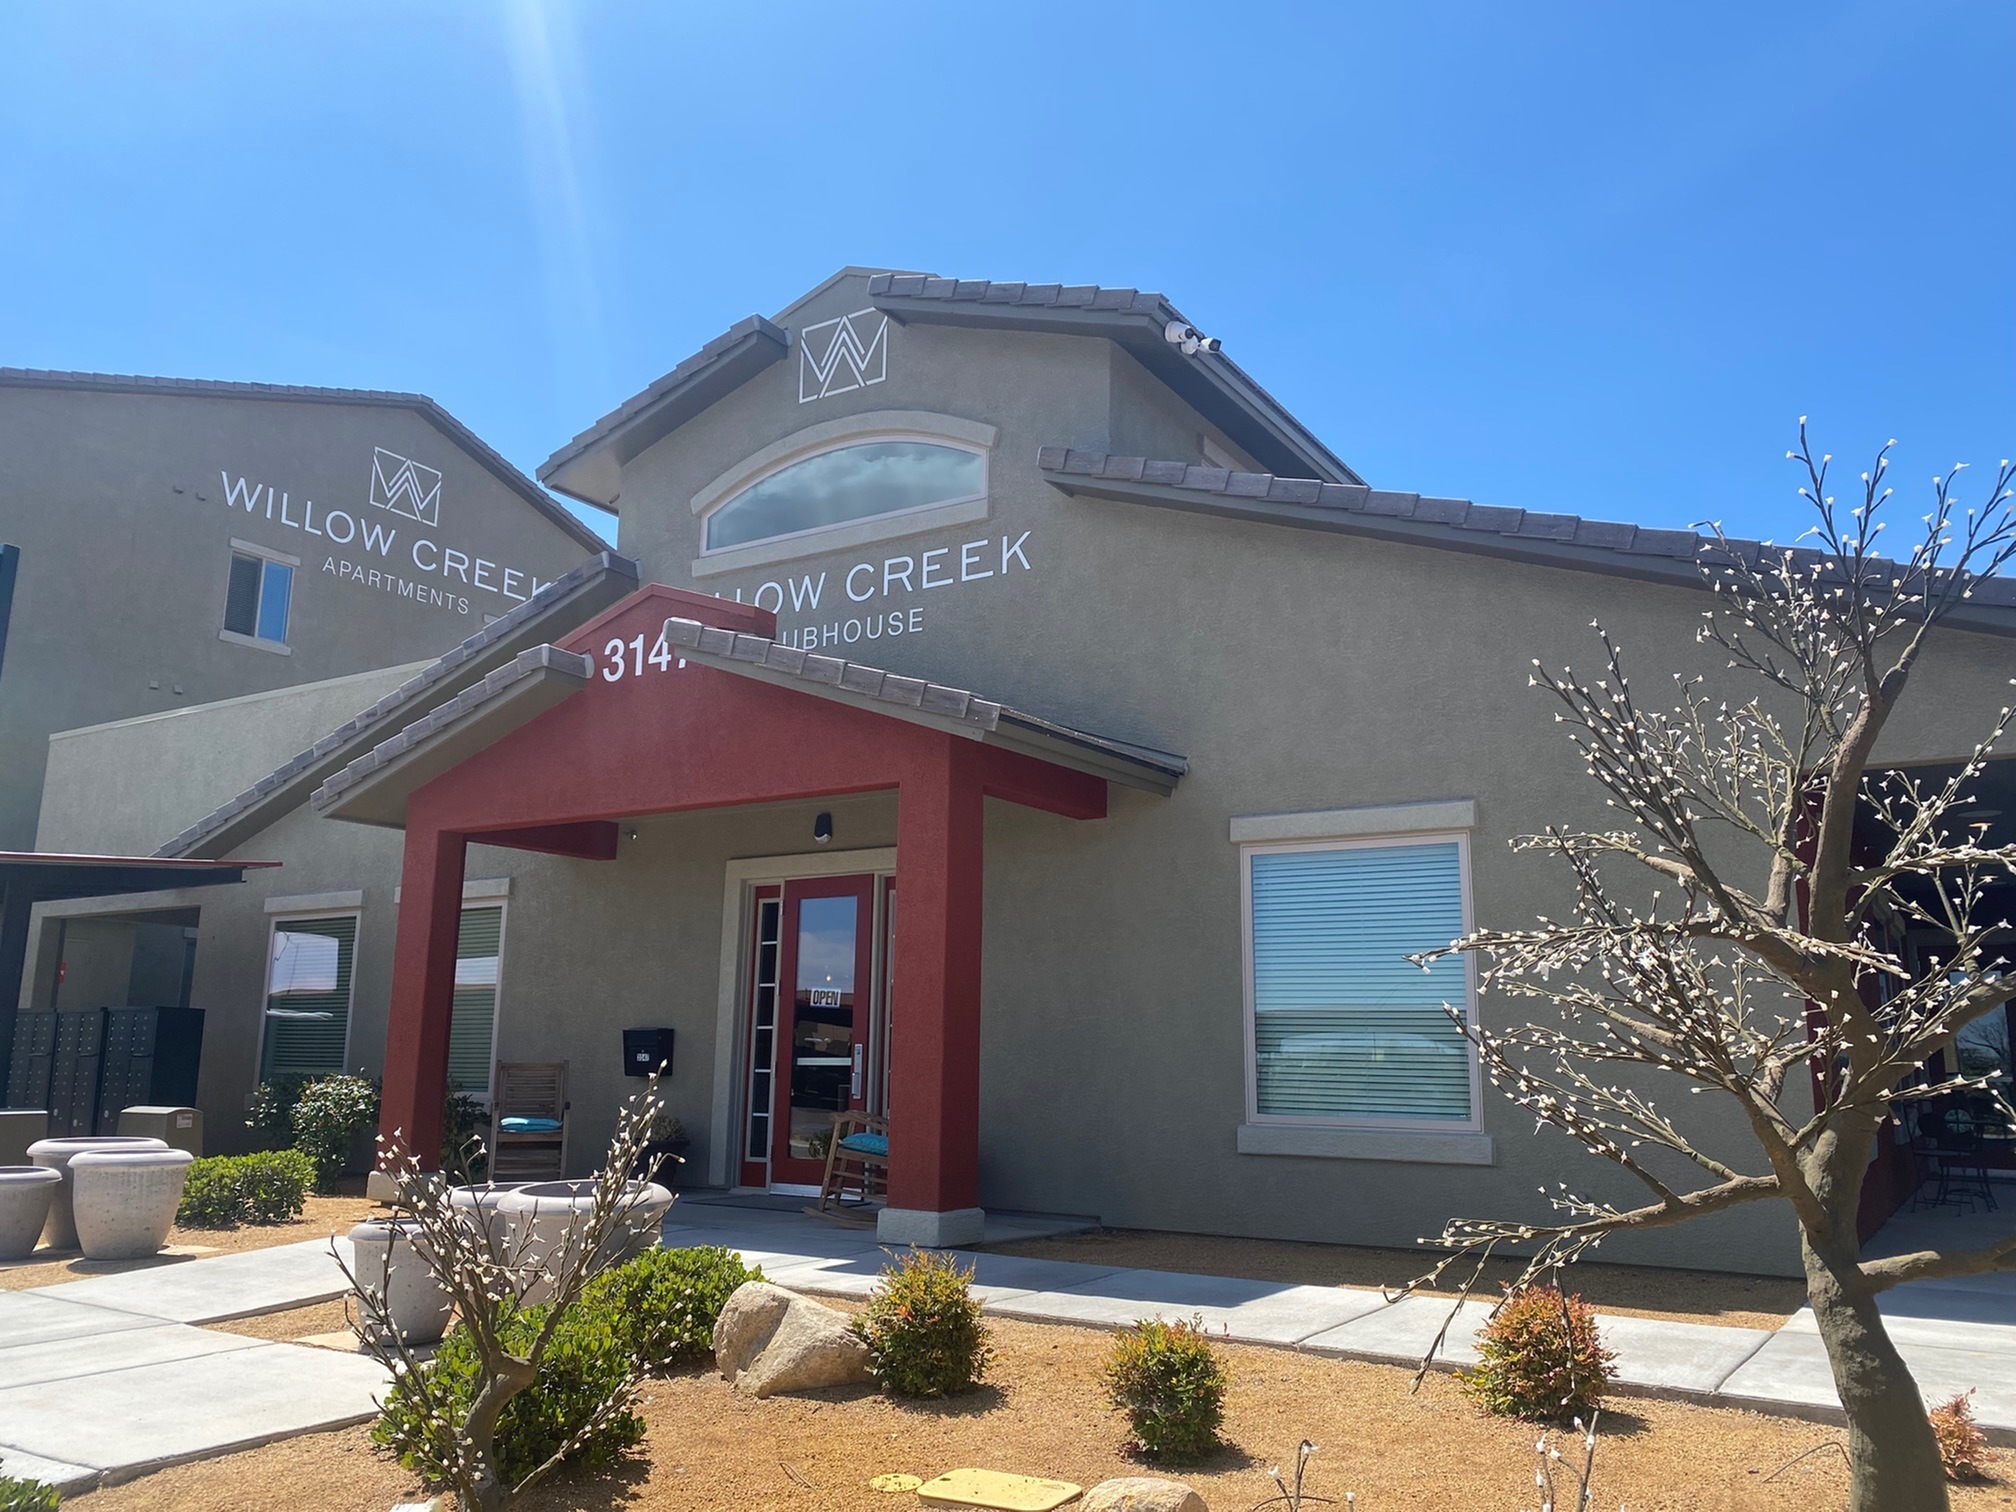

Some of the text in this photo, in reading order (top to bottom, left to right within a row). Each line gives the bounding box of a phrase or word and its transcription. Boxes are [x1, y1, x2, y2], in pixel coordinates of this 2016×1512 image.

[220, 470, 397, 557] WILLOW
[321, 556, 469, 615] APARTMENTS
[845, 530, 1033, 603] CREEK
[602, 633, 687, 682] 314
[812, 990, 839, 1006] OPEN
